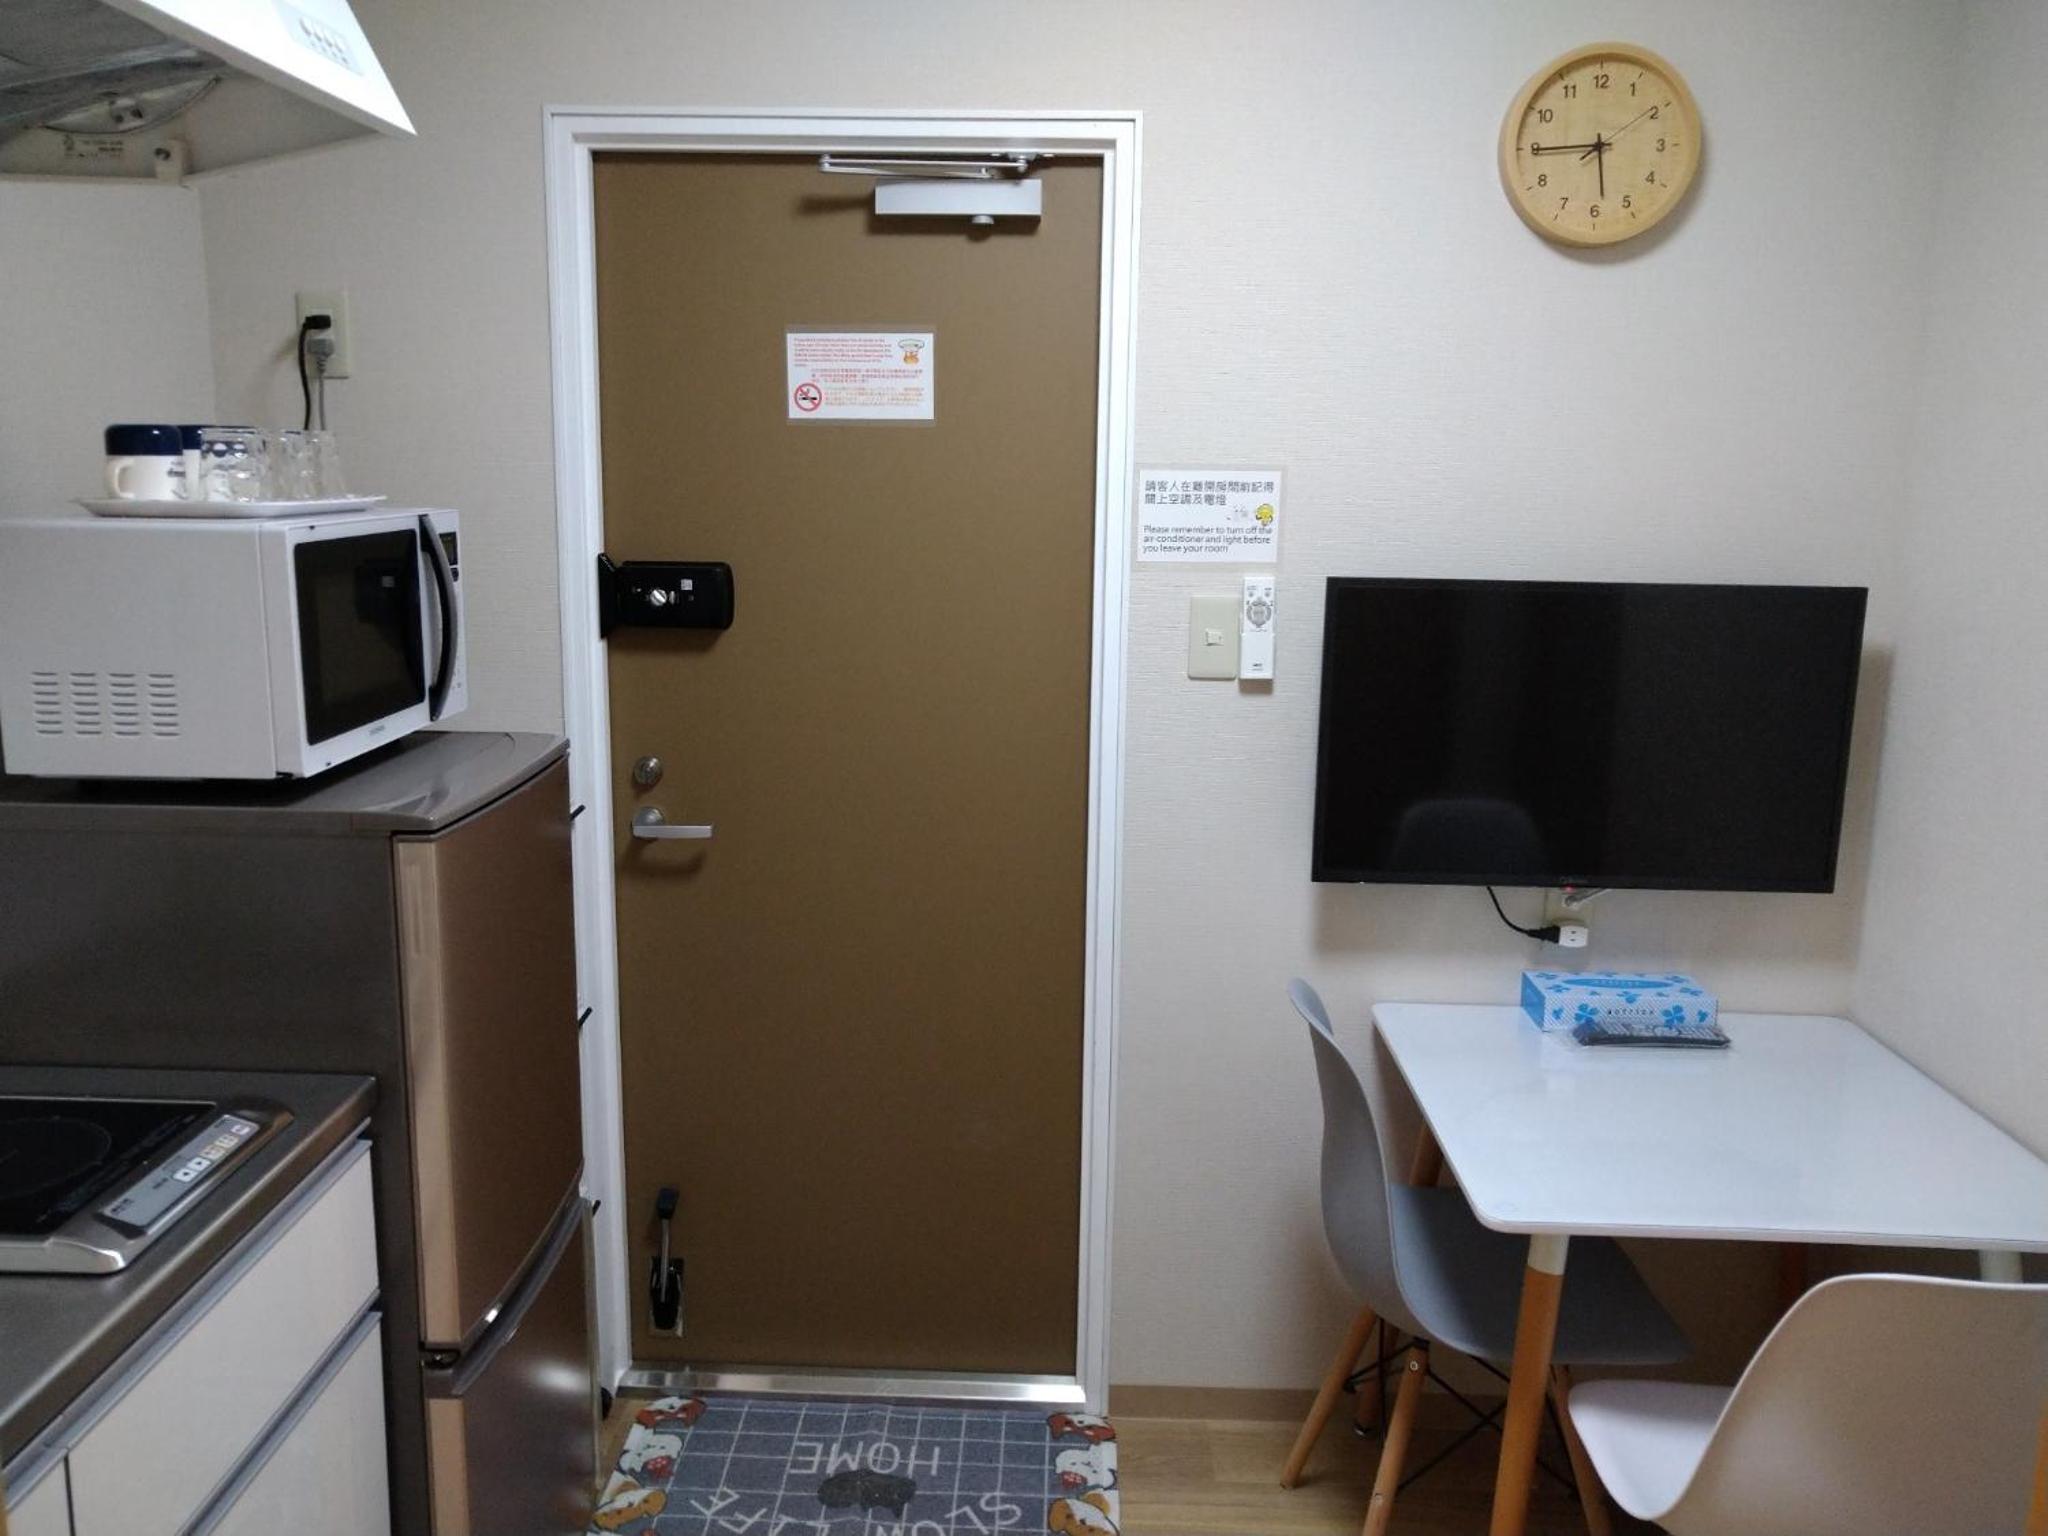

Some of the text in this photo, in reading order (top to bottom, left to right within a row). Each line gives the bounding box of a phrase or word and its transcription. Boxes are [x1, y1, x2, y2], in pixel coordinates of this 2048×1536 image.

[1593, 74, 1610, 89] 12
[1562, 84, 1577, 99] 11
[1629, 83, 1636, 97] 1
[1537, 109, 1554, 123] 10
[1649, 105, 1659, 120] 2
[1656, 138, 1666, 152] 3
[1537, 174, 1548, 187] 8
[1645, 171, 1655, 185] 4
[1559, 197, 1569, 210] 7
[1622, 195, 1631, 209] 5
[1590, 204, 1600, 218] 6
[1143, 525, 1169, 534] Please
[1171, 525, 1214, 534] remember
[1216, 526, 1226, 534] to
[1245, 525, 1258, 534] off
[1258, 525, 1273, 534] the
[1205, 535, 1221, 543] and
[1223, 534, 1242, 545] light
[1243, 534, 1271, 544] before
[1143, 545, 1159, 554] you
[1160, 543, 1182, 552] leave
[1183, 545, 1203, 554] your
[789, 1440, 941, 1477] HOME
